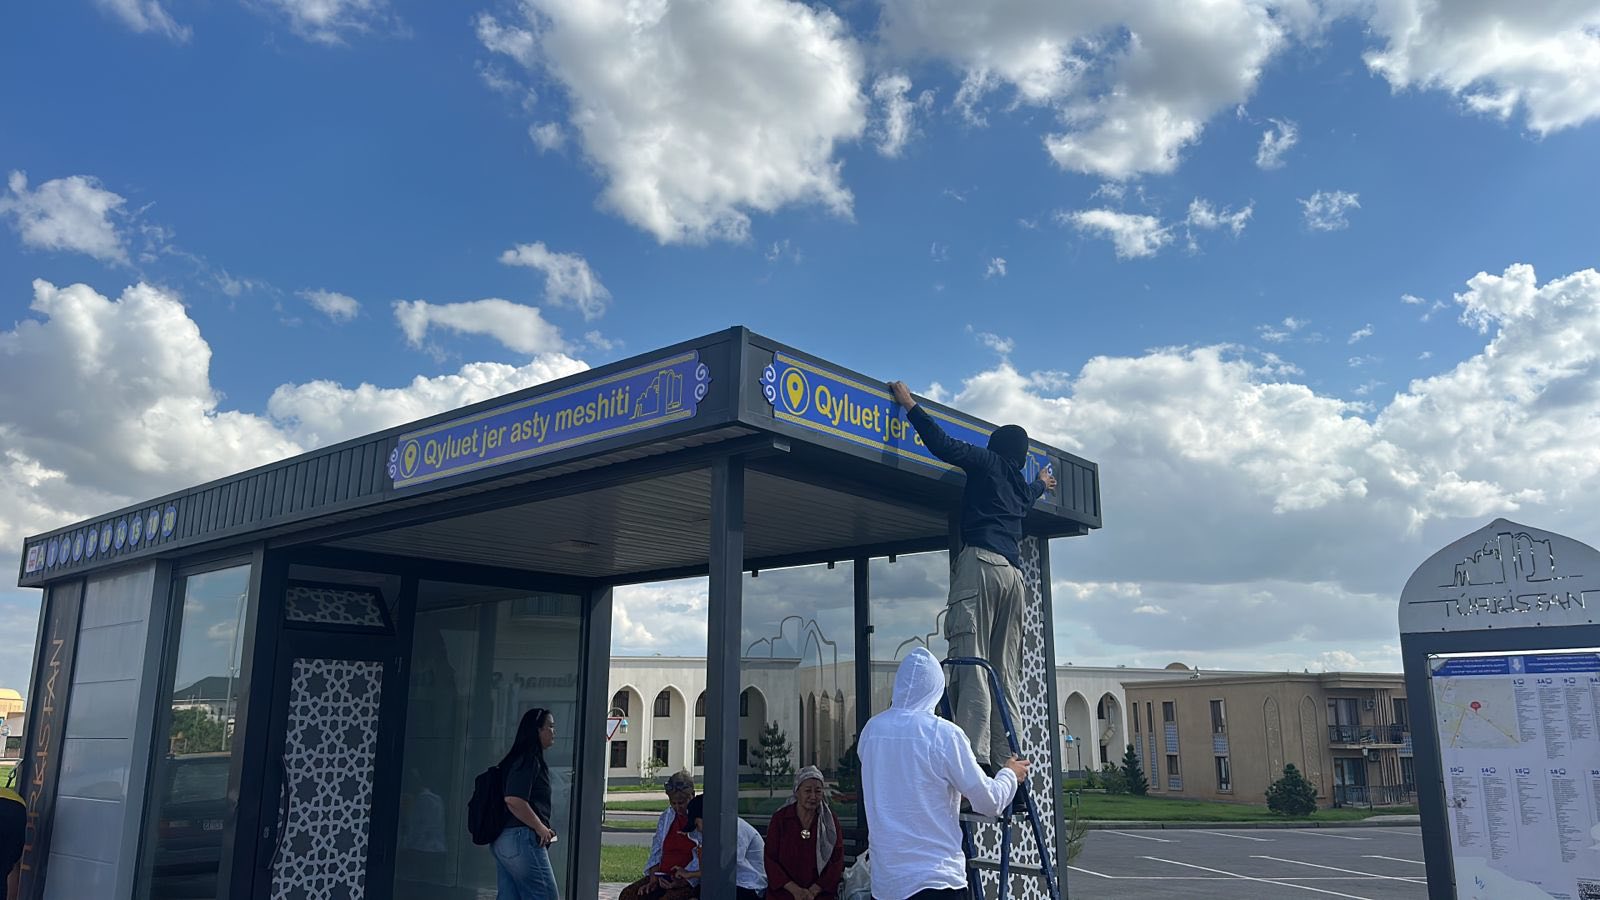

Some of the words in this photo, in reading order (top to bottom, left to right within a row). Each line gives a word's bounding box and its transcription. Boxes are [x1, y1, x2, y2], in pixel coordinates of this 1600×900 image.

[424, 430, 478, 467] Qyluet
[481, 424, 505, 456] jer
[511, 411, 550, 443] asty
[555, 386, 631, 432] meshiti
[815, 385, 880, 433] Qyluet
[882, 408, 910, 442] jer
